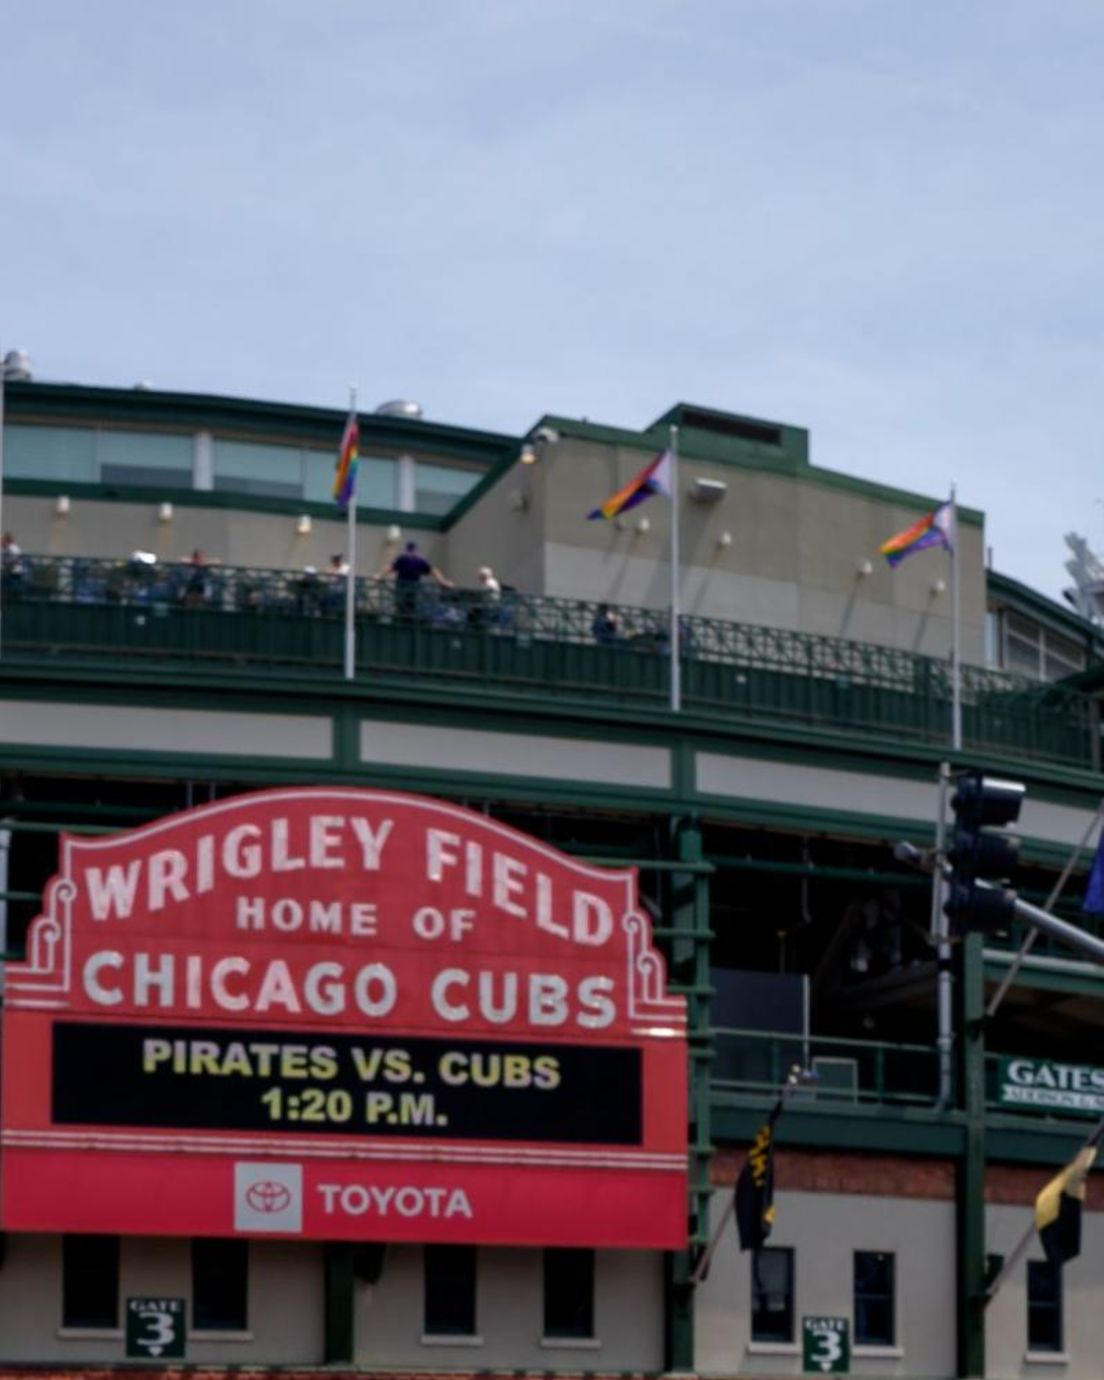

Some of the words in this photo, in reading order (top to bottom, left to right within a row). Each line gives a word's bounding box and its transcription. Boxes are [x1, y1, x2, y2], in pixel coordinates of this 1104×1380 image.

[85, 815, 393, 921] WRIGLEY
[426, 828, 614, 946] FIELD
[236, 897, 377, 936] HOME
[413, 907, 476, 942] OF
[83, 951, 397, 1016] CHICAGO
[431, 968, 616, 1028] CUBS
[142, 1039, 337, 1080] PIRATES
[351, 1049, 424, 1083] VS.
[439, 1052, 561, 1090] CUBS
[261, 1088, 352, 1122] 1:20
[366, 1093, 449, 1126] P.M.
[318, 1184, 473, 1219] TOYOTA
[137, 1311, 175, 1346] 3
[811, 1330, 841, 1362] 3
